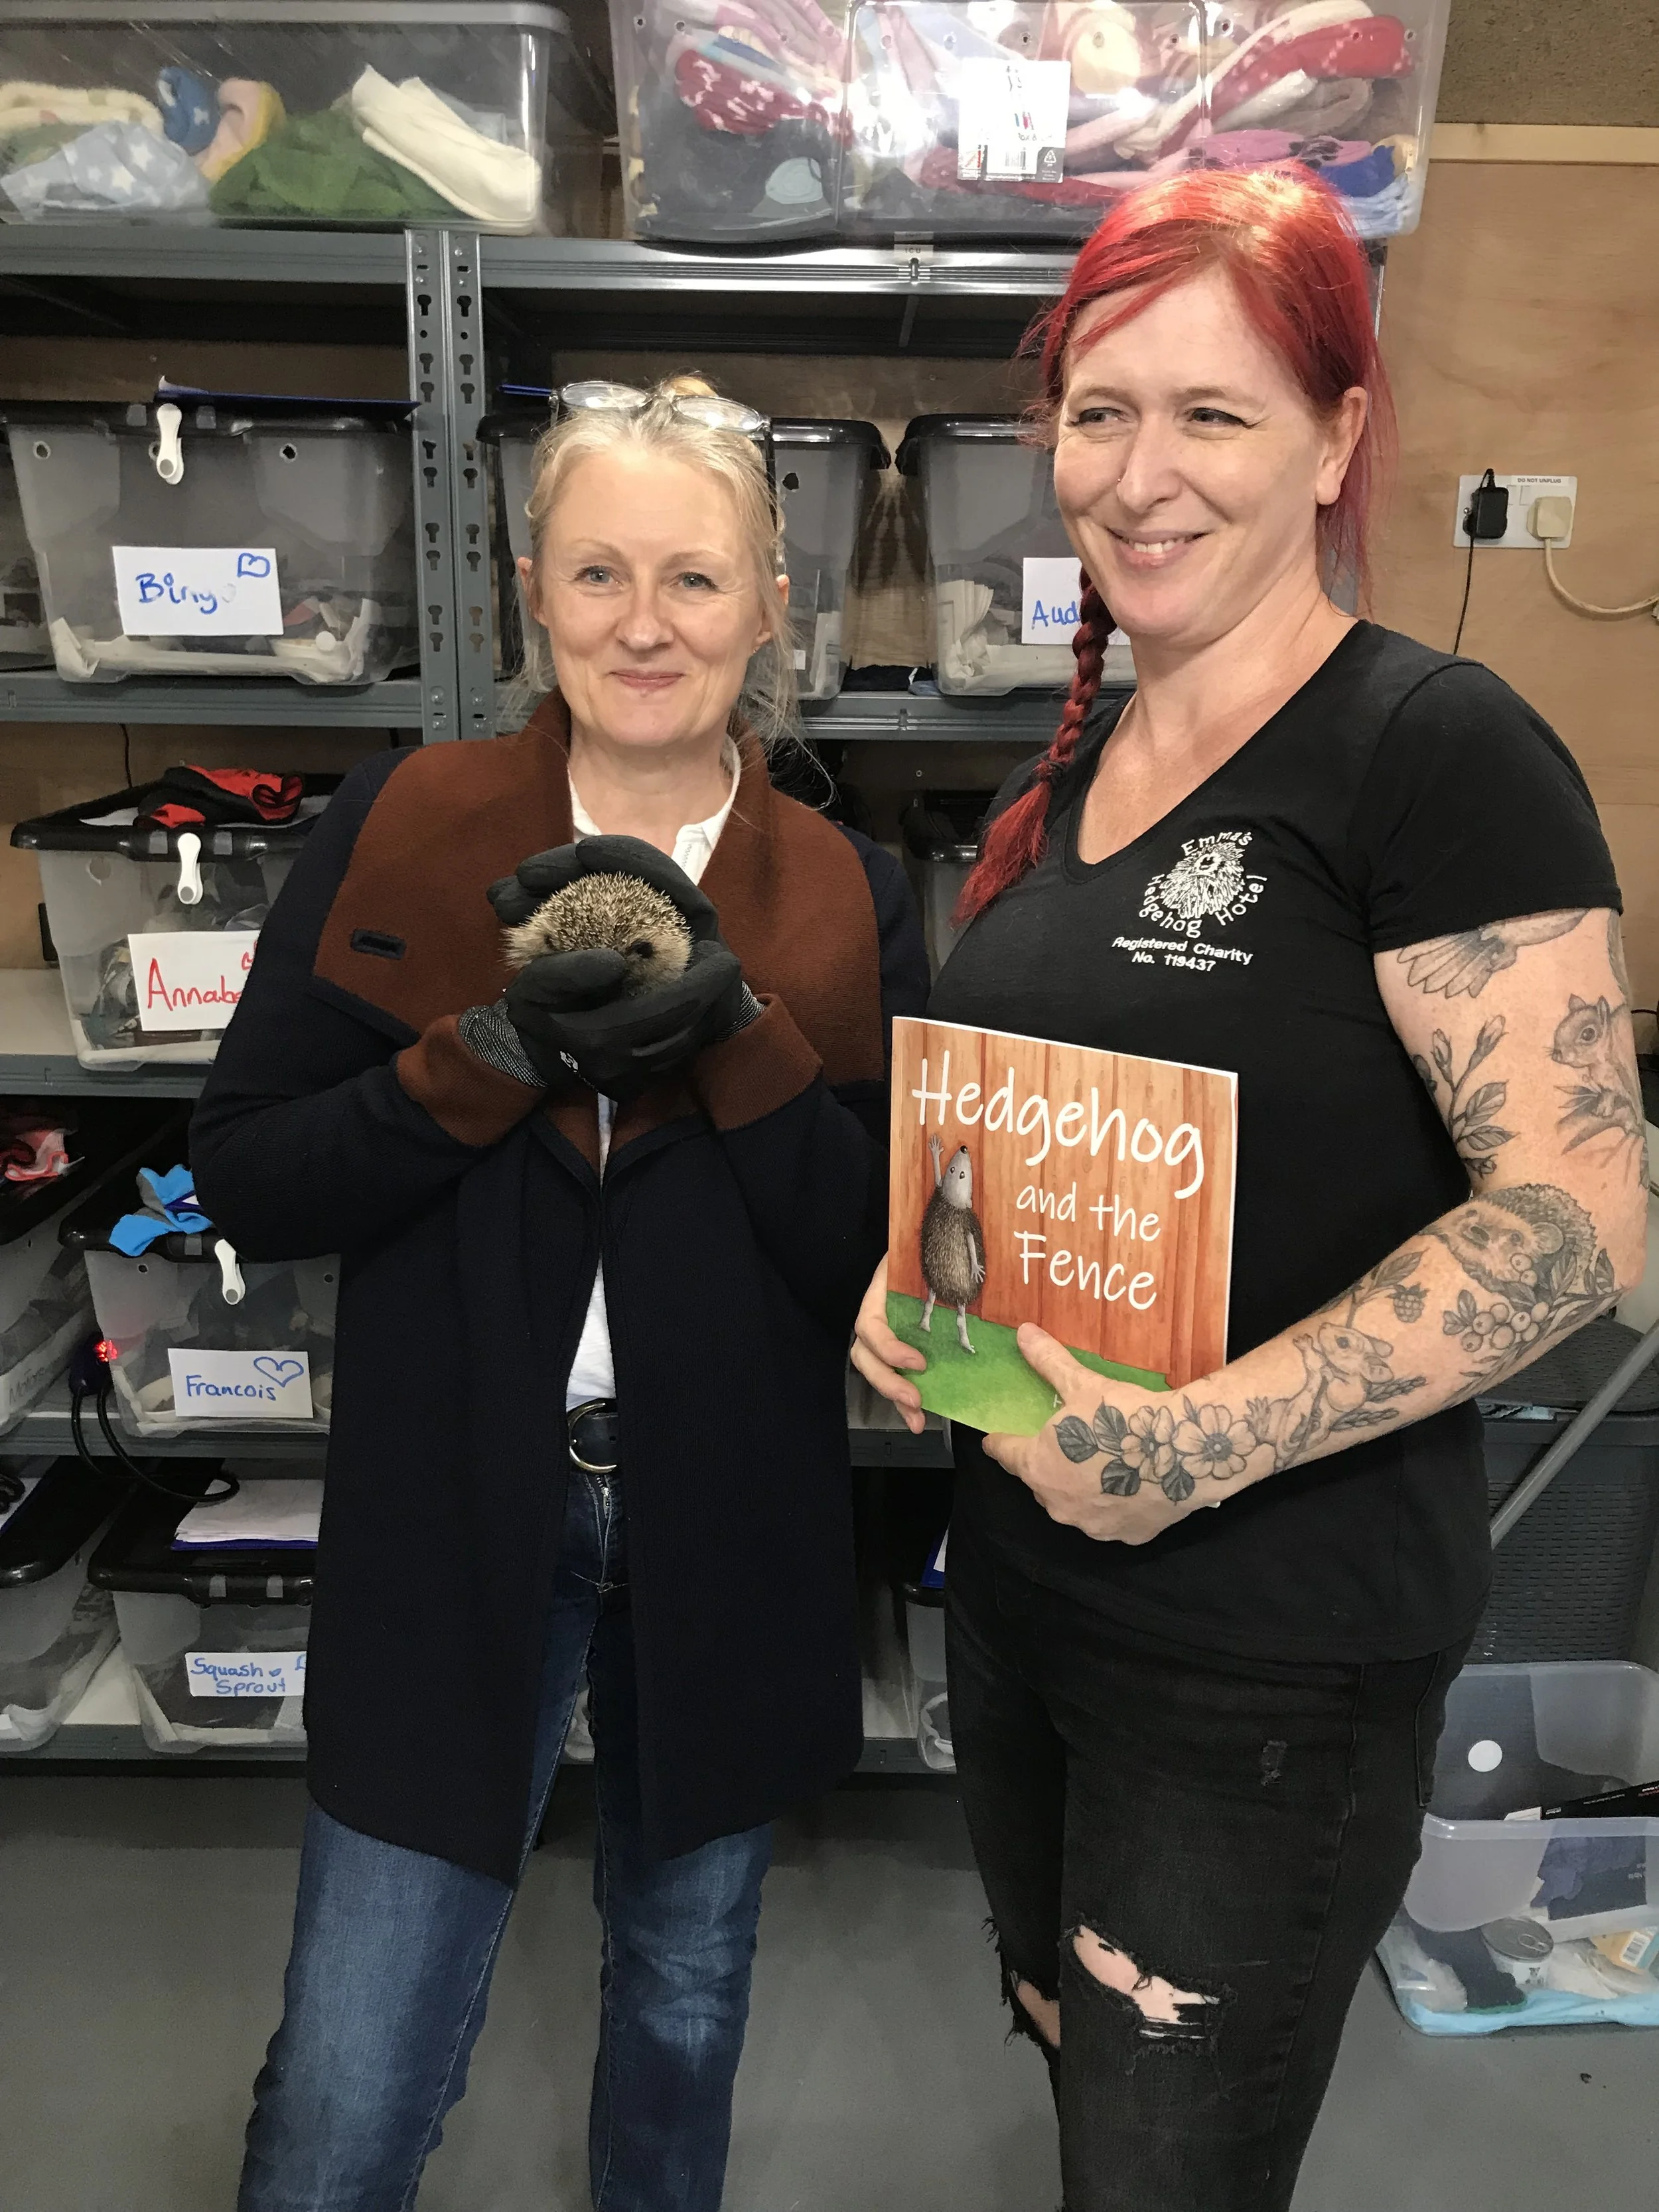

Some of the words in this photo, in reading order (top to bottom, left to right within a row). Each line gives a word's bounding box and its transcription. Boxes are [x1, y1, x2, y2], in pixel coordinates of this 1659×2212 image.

[1031, 599, 1081, 630] Aud
[1139, 873, 1202, 938] Hedgehog
[1214, 874, 1267, 926] Hotel
[1112, 936, 1188, 952] Registered
[1193, 942, 1254, 965] Charity
[1131, 951, 1155, 964] No.
[1164, 954, 1216, 972] 119437
[911, 1050, 1204, 1200] Hedgehog
[1016, 1181, 1077, 1222] and
[1089, 1193, 1161, 1242] the
[1013, 1230, 1157, 1311] Fence
[186, 1374, 276, 1401] Francois
[190, 1657, 263, 1682] Squash
[216, 1677, 285, 1697] Sprout
